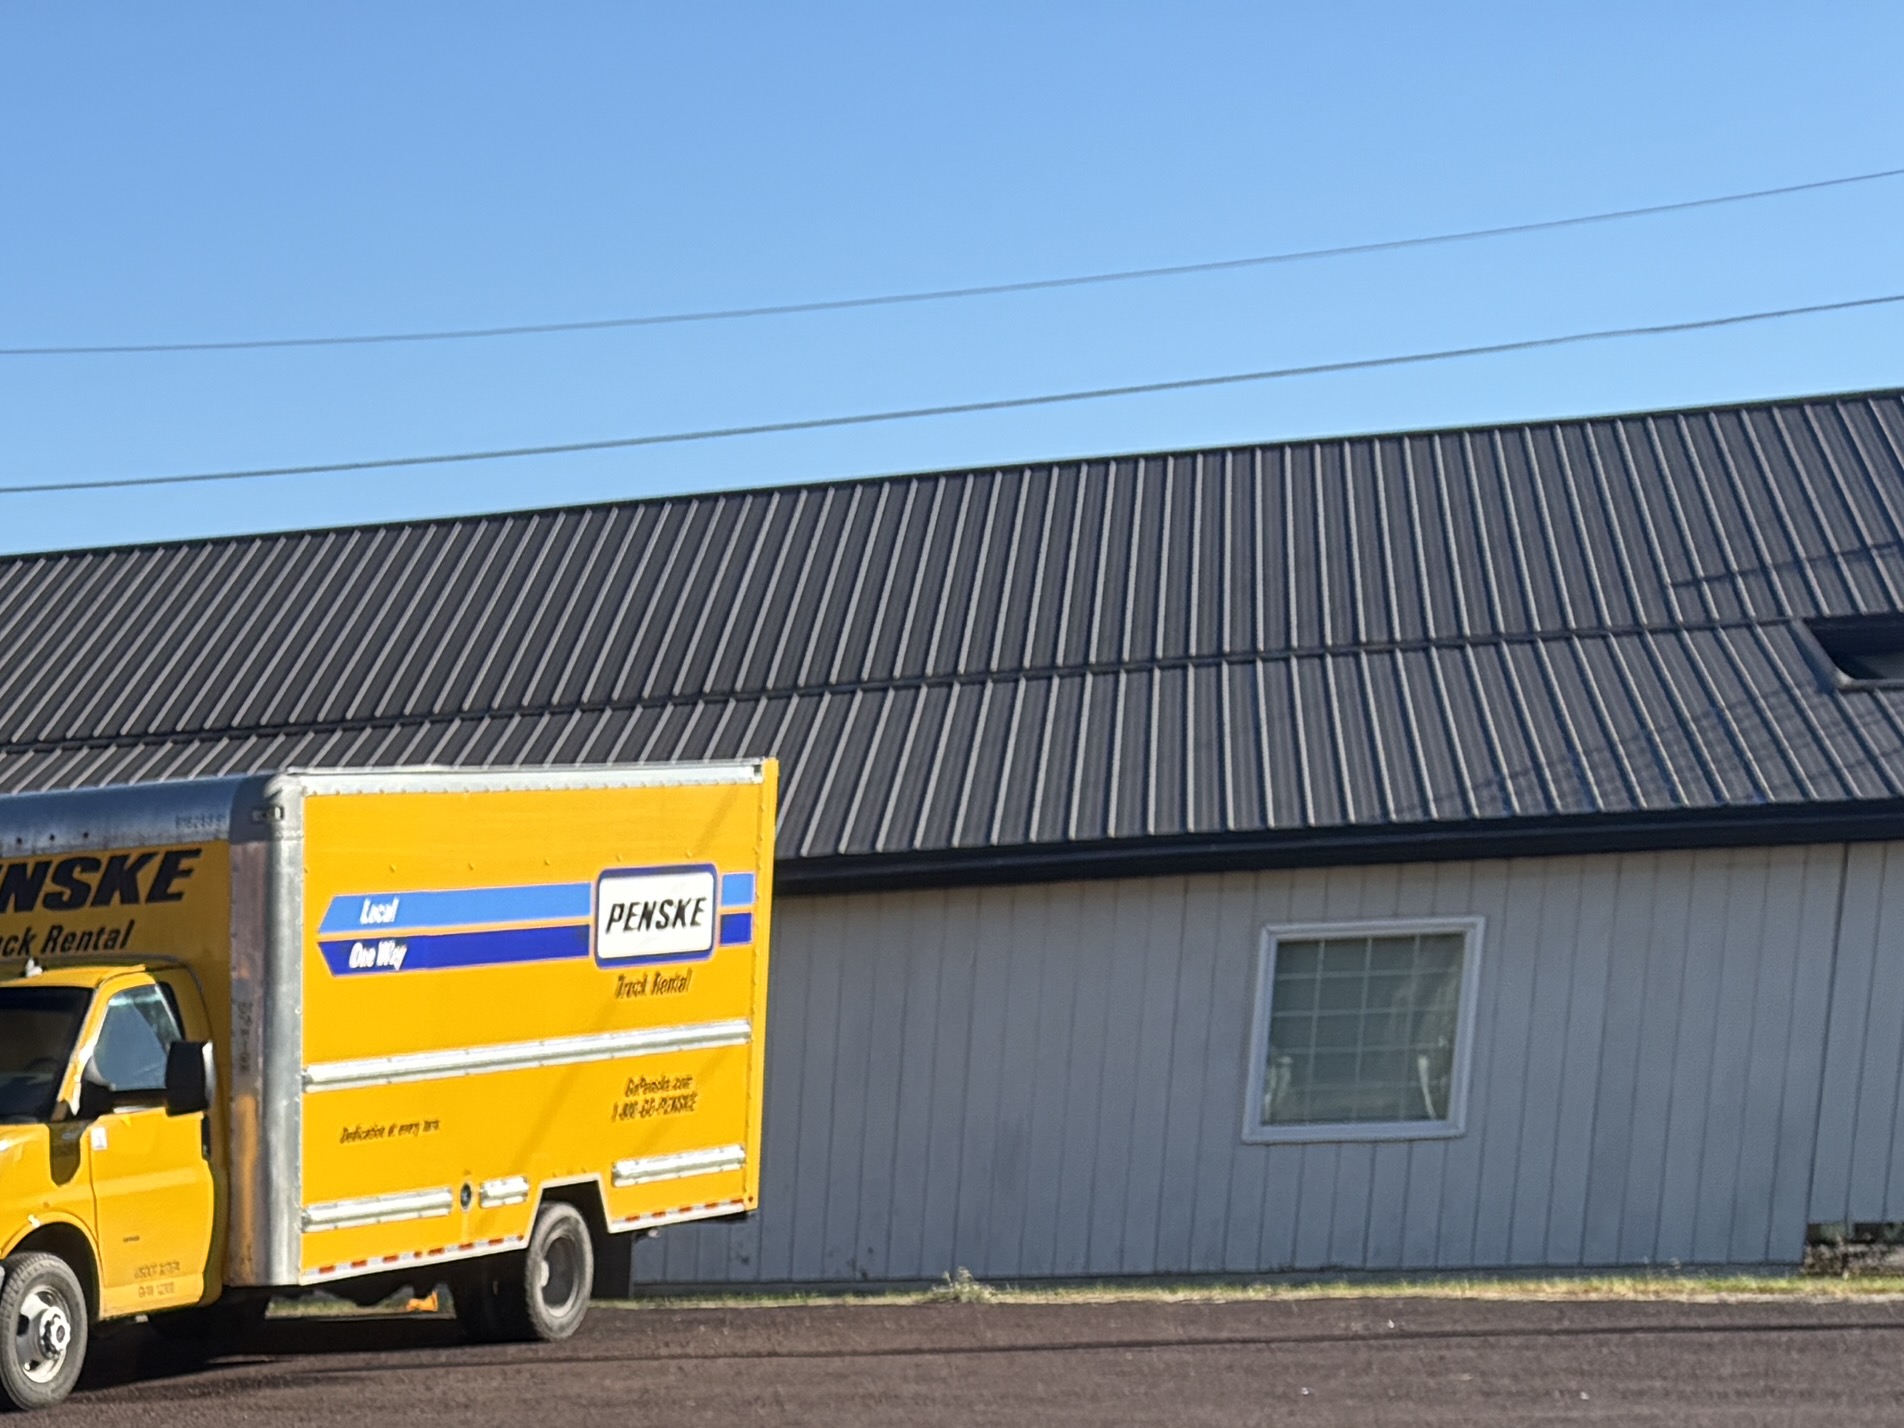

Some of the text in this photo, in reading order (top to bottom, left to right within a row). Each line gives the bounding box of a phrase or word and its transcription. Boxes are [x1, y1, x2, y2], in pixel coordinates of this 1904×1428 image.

[359, 897, 400, 925] Local
[605, 897, 707, 934] PENSKE
[41, 919, 135, 954] Rental
[348, 939, 408, 971] One Way
[615, 967, 693, 1000] Truck Rental
